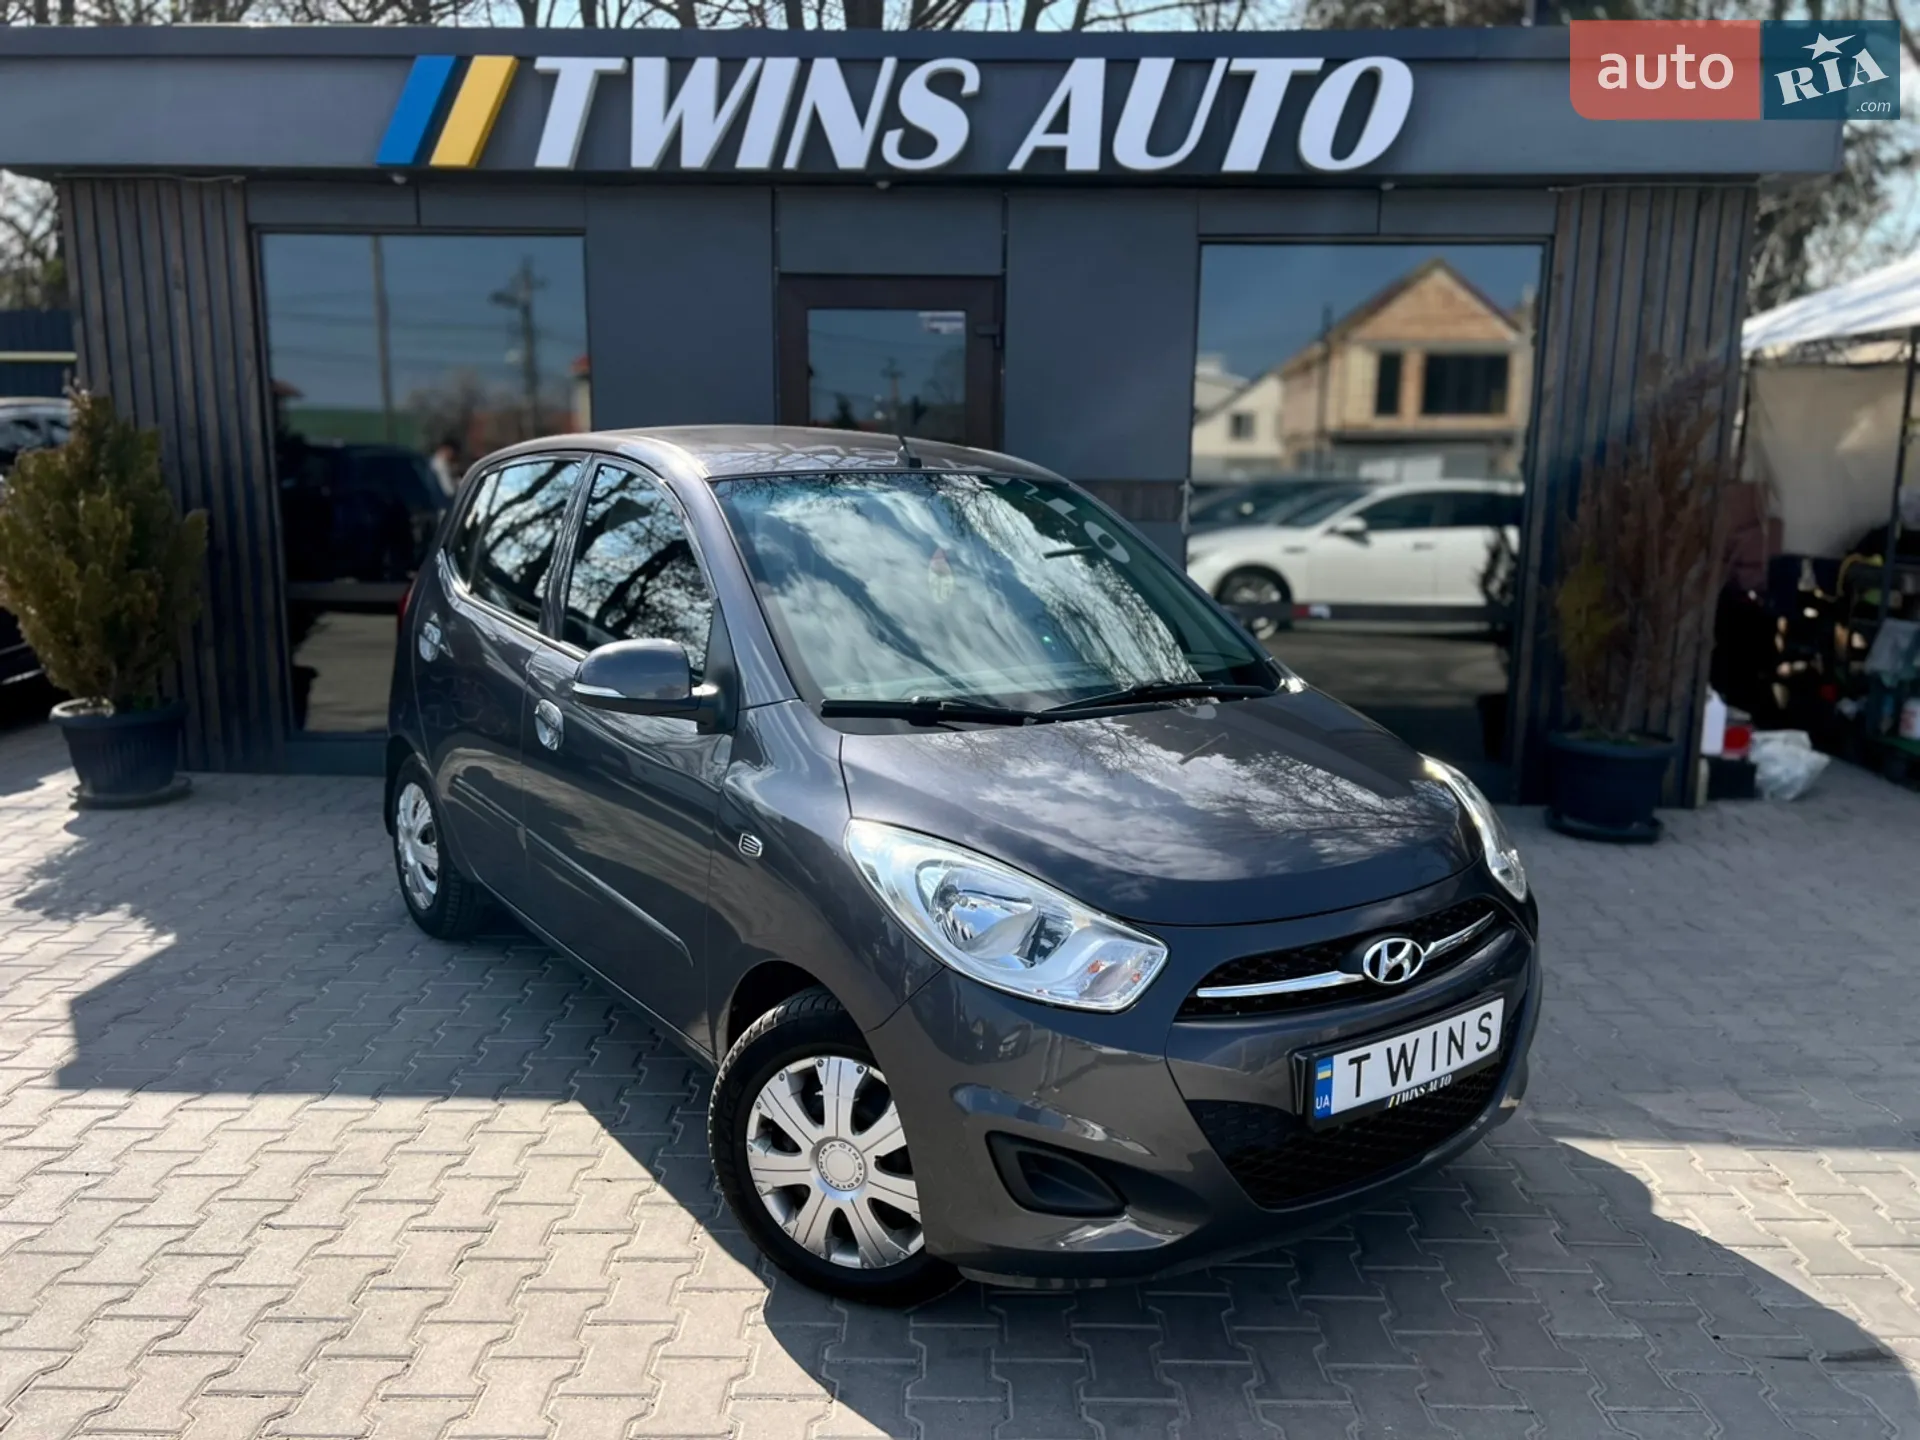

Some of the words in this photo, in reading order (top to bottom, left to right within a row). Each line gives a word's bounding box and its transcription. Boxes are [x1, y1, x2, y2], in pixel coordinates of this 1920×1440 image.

[534, 56, 981, 171] TWINS
[1007, 56, 1414, 171] AUTO
[1315, 1096, 1330, 1109] UA
[1395, 1084, 1426, 1106] TWINS
[1427, 1074, 1452, 1094] AUTO
